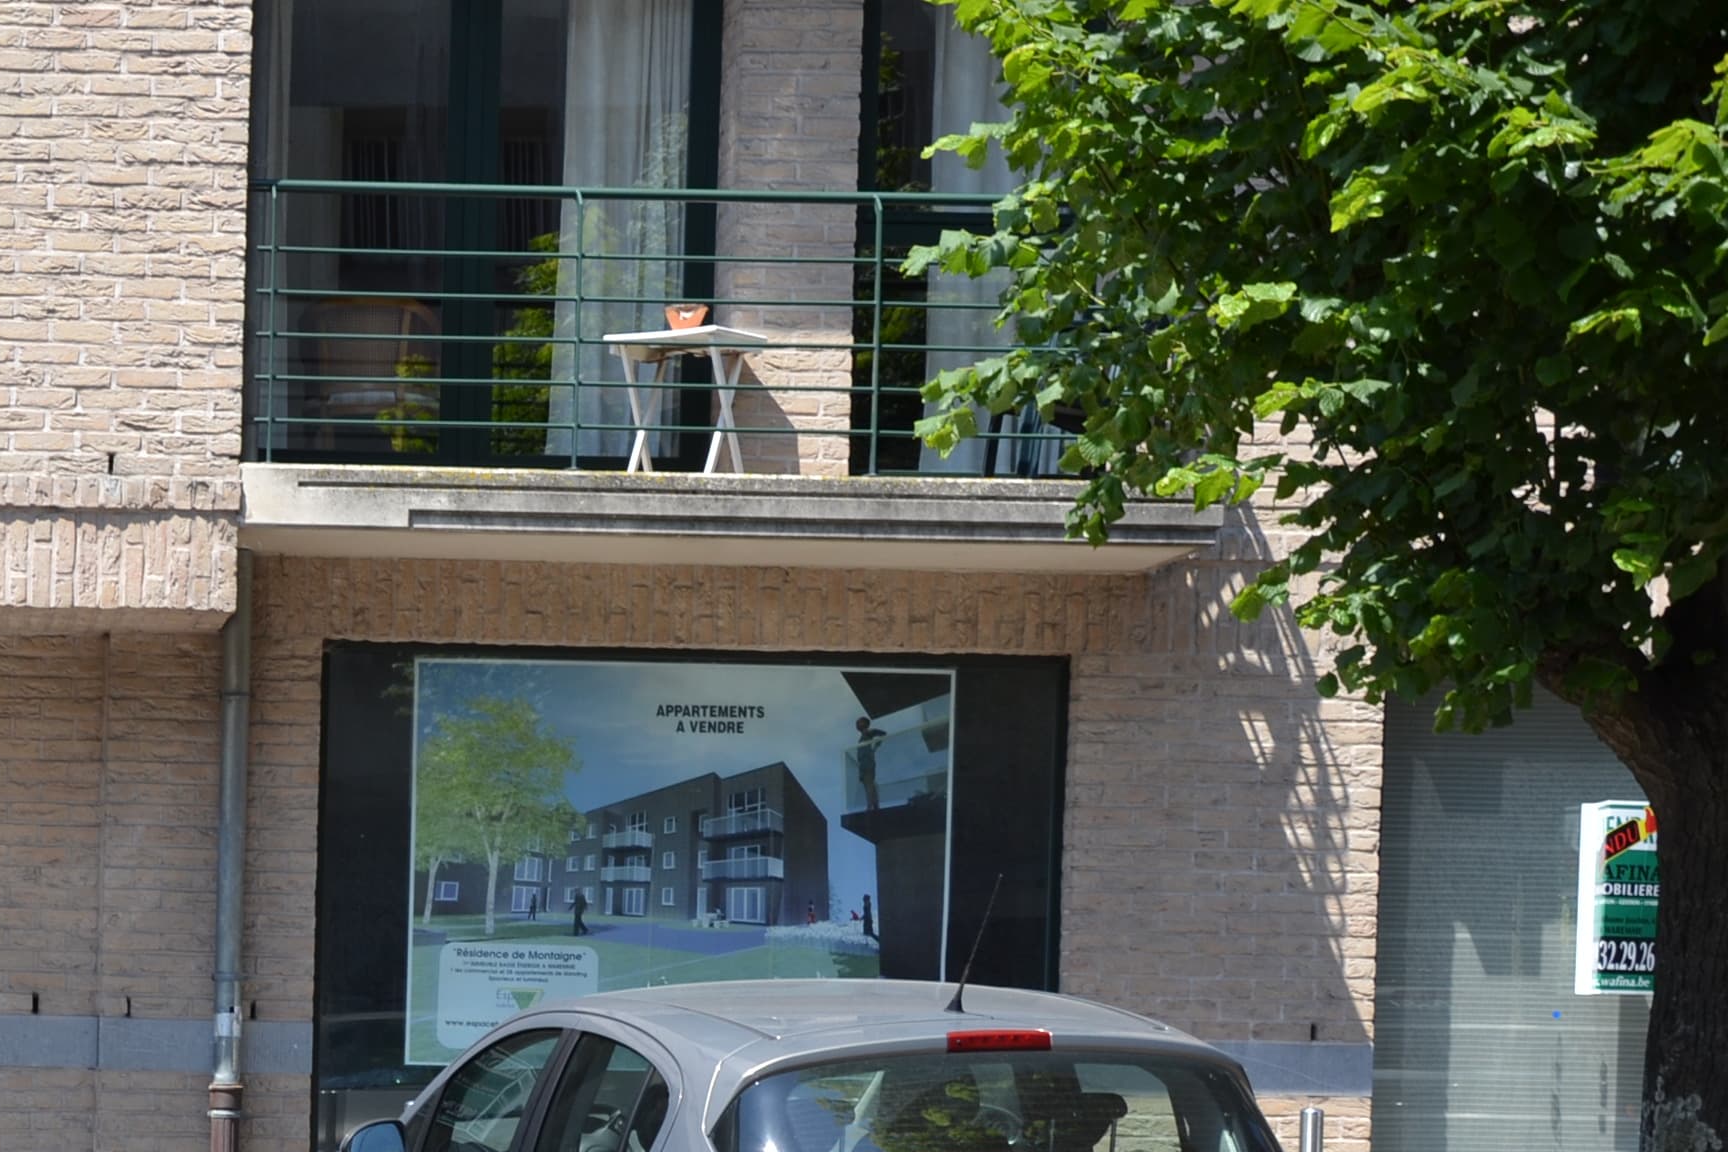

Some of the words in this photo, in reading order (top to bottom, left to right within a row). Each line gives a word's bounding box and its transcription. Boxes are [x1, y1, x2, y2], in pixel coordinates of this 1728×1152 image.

[655, 704, 766, 719] APPARTEMENTS
[675, 720, 685, 733] A
[689, 721, 745, 734] VENDRE
[1605, 824, 1640, 855] NDU
[1603, 863, 1661, 881] AFINA
[1601, 882, 1661, 897] OBILIERE
[511, 950, 526, 960] de
[1598, 940, 1656, 972] 32.29.26
